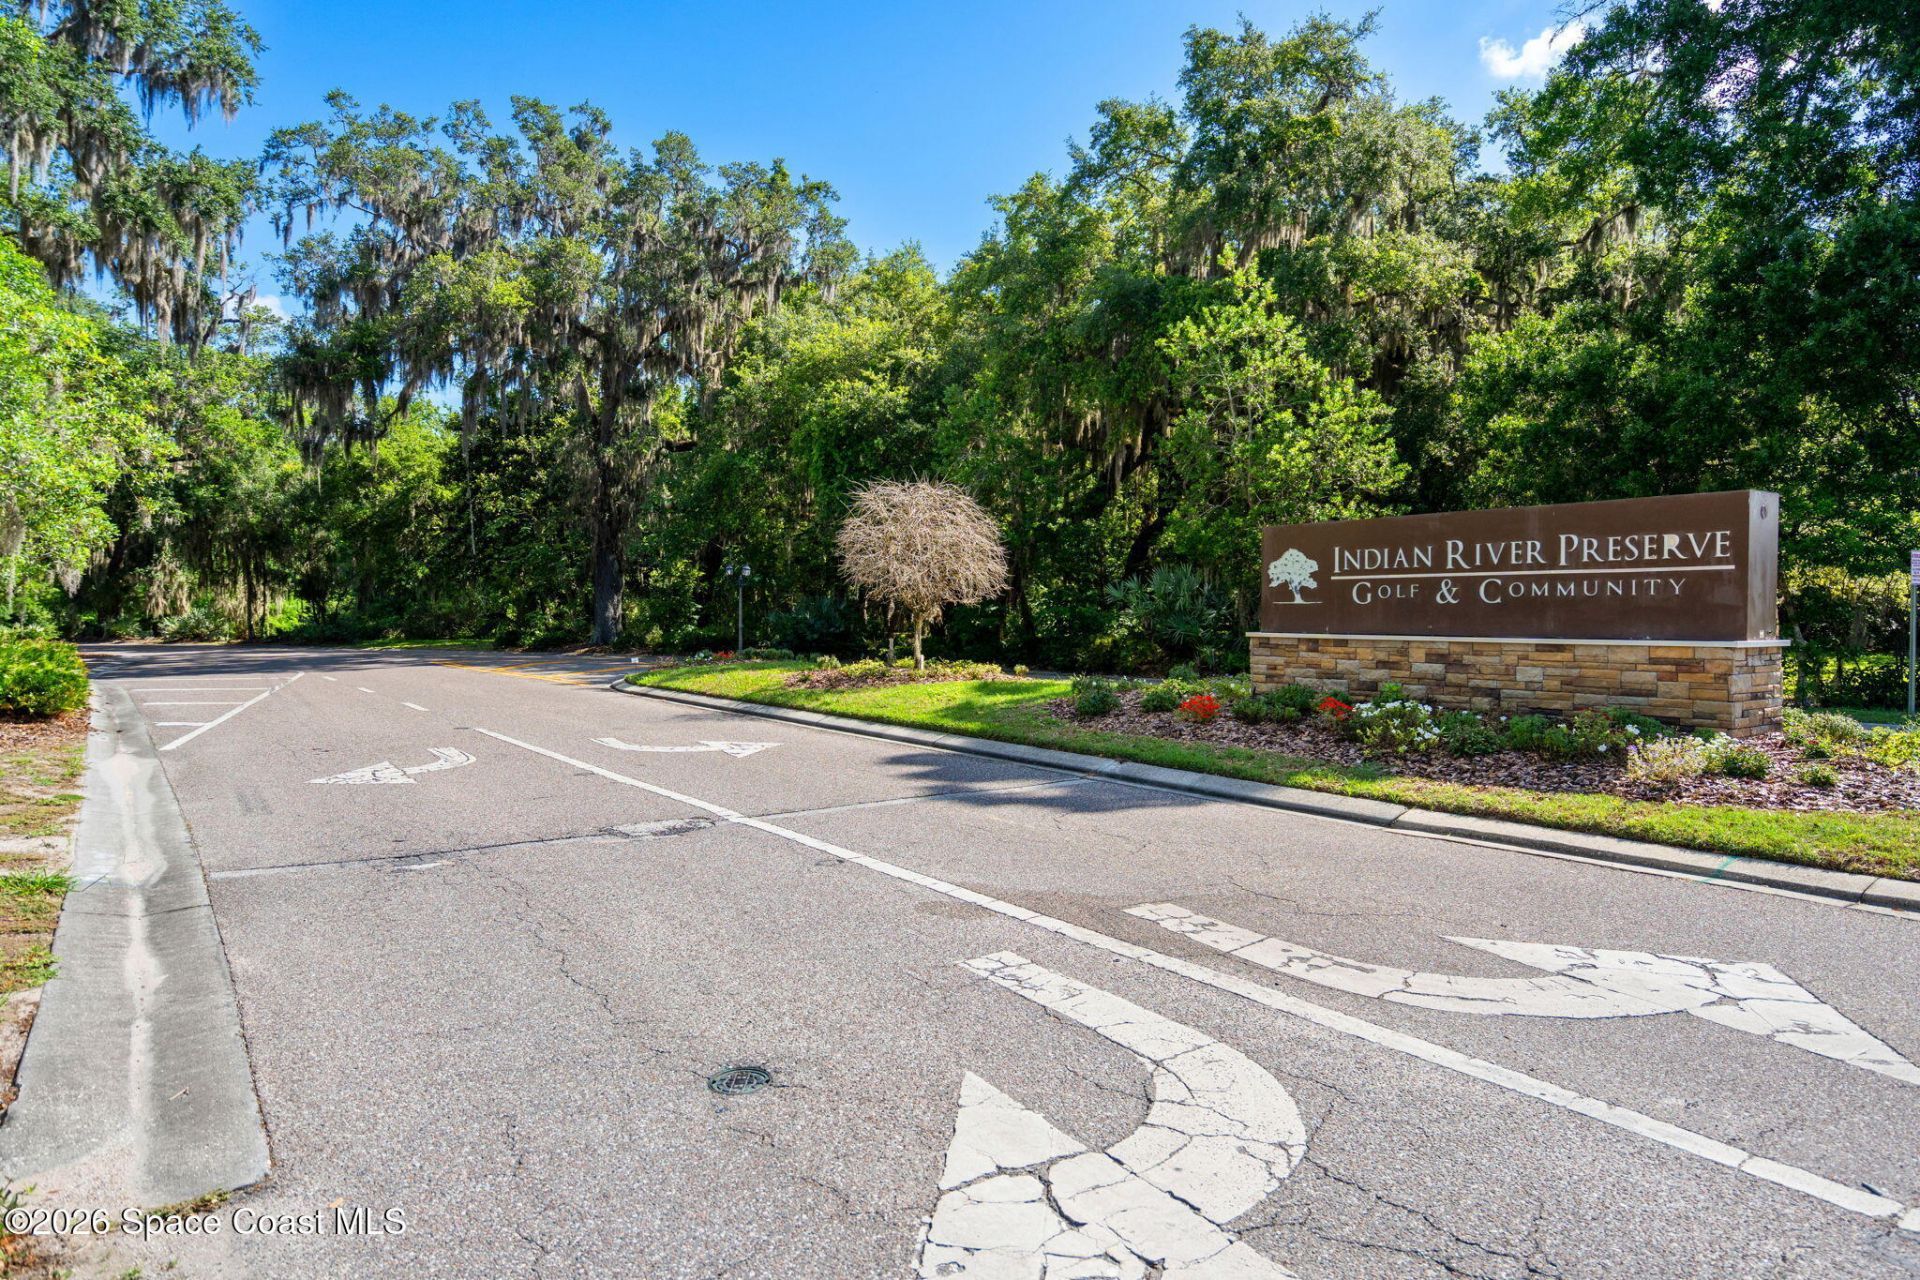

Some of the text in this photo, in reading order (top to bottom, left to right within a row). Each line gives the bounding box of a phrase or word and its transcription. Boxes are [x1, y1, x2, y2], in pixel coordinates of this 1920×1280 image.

[1334, 531, 1731, 573] INDIAN RIVER PRESERVE
[1352, 578, 1686, 605] GOLF & COMMUNITY
